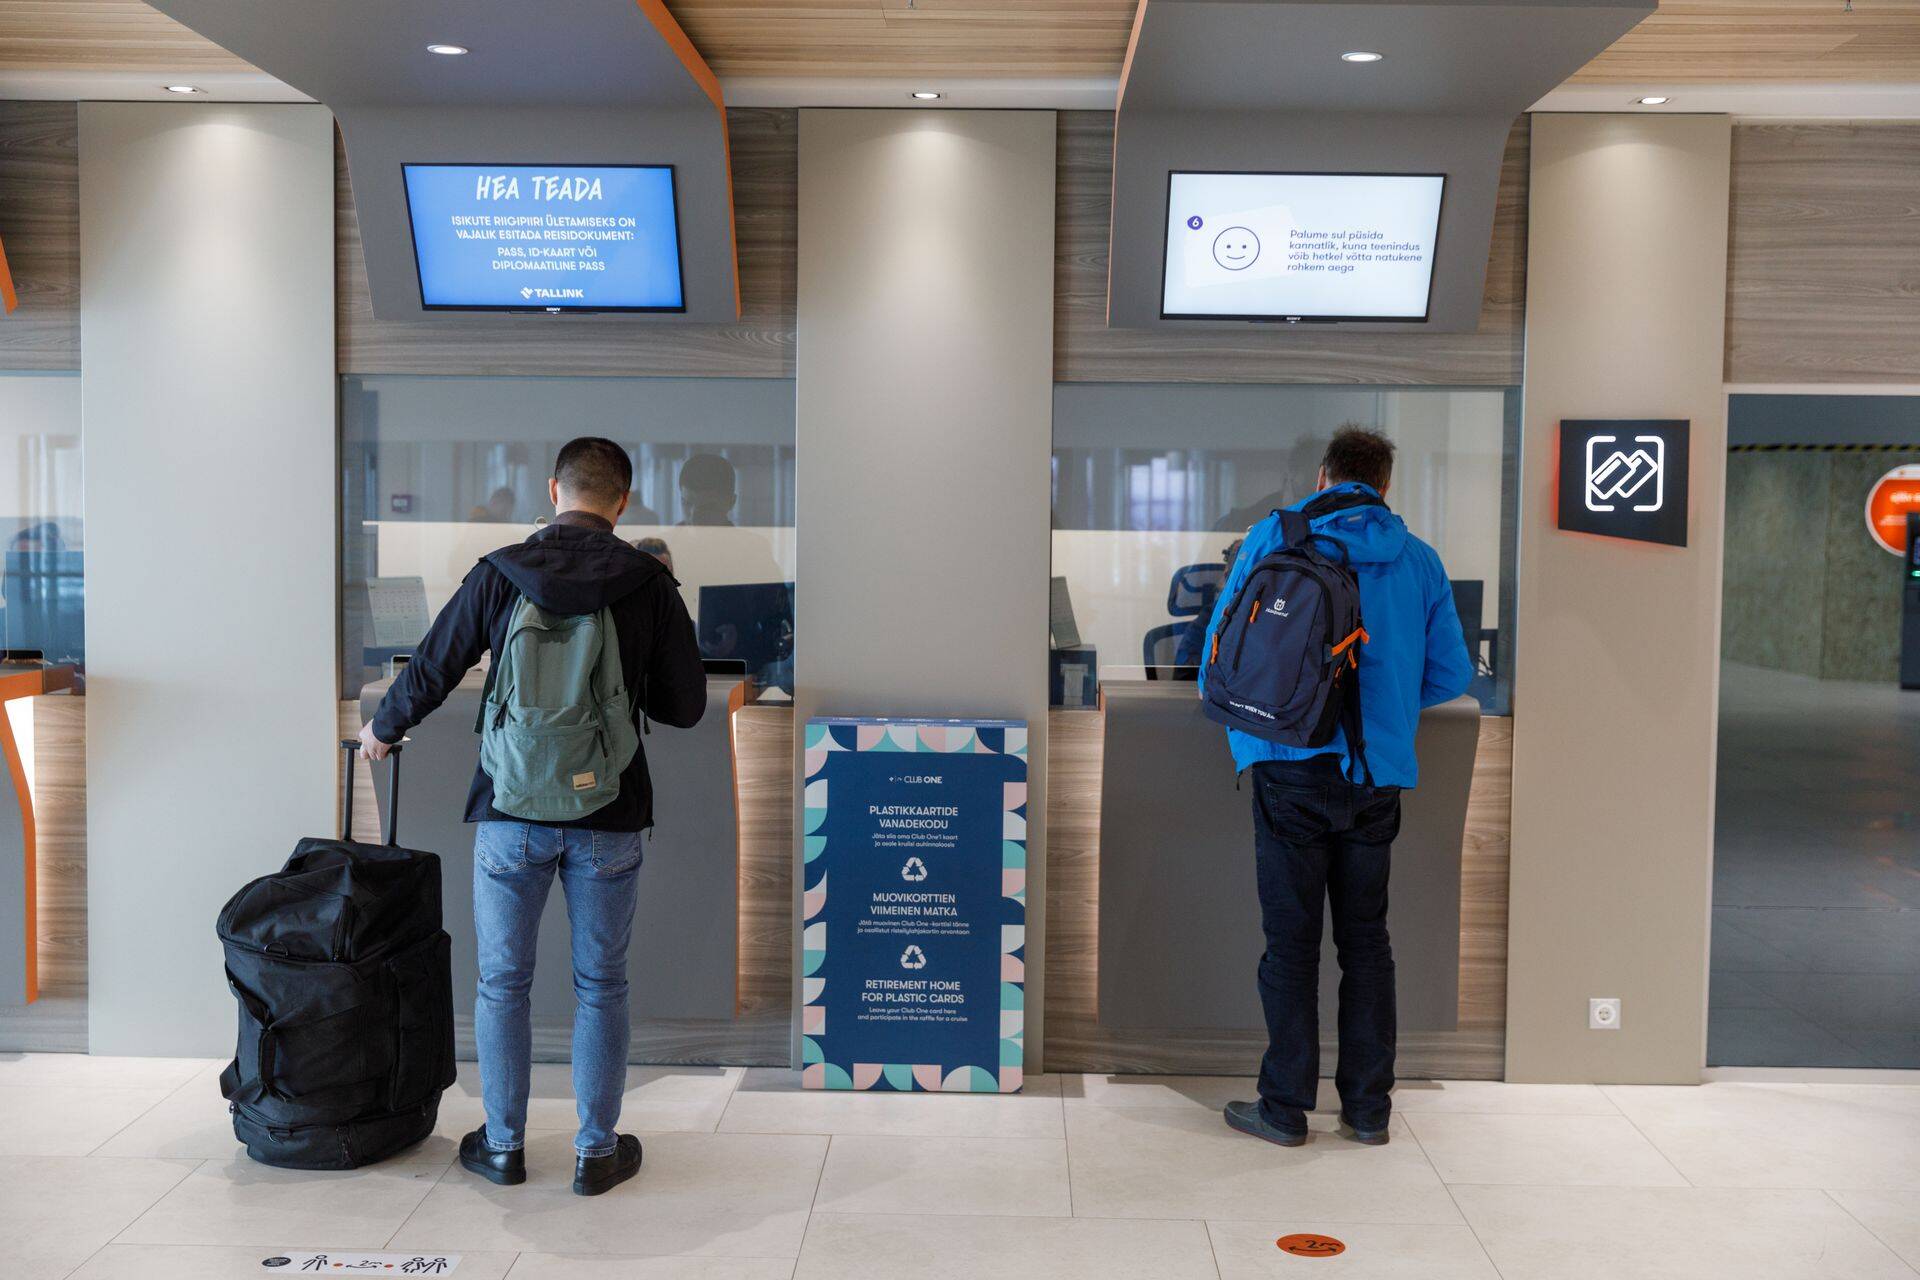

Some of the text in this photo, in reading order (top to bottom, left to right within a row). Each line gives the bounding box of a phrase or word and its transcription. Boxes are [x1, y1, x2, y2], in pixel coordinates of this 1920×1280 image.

[476, 175, 602, 202] HEA TEADA
[452, 214, 636, 228] ISIKUTE RIIGIPIIRI ÜLETAMISEKS ON
[1192, 218, 1200, 228] 6
[456, 230, 634, 241] VAJALIK ESITADA REISIDOKUMENT:
[1290, 230, 1384, 242] Palume sul püsida
[498, 245, 597, 258] PASS, ID-KAART VÕI
[1289, 242, 1420, 252] kannatlik, kuna teenindus
[1288, 252, 1422, 262] võib hetkel võtta natukene
[492, 260, 606, 271] DIPLOMAATILINE PASS
[1288, 263, 1354, 274] rohkem aega
[534, 288, 584, 298] TALLINK
[870, 806, 958, 816] PLASTIKKAARTIDE
[879, 819, 948, 829] VANADEKODU
[873, 893, 955, 903] MUOVIKORTTIEN
[870, 906, 958, 916] VIIMEINEN MATKA
[866, 980, 960, 991] RETIREMENT HOME
[862, 993, 964, 1004] FOR PLASTIC CARDS
[1305, 1240, 1341, 1248] 2m
